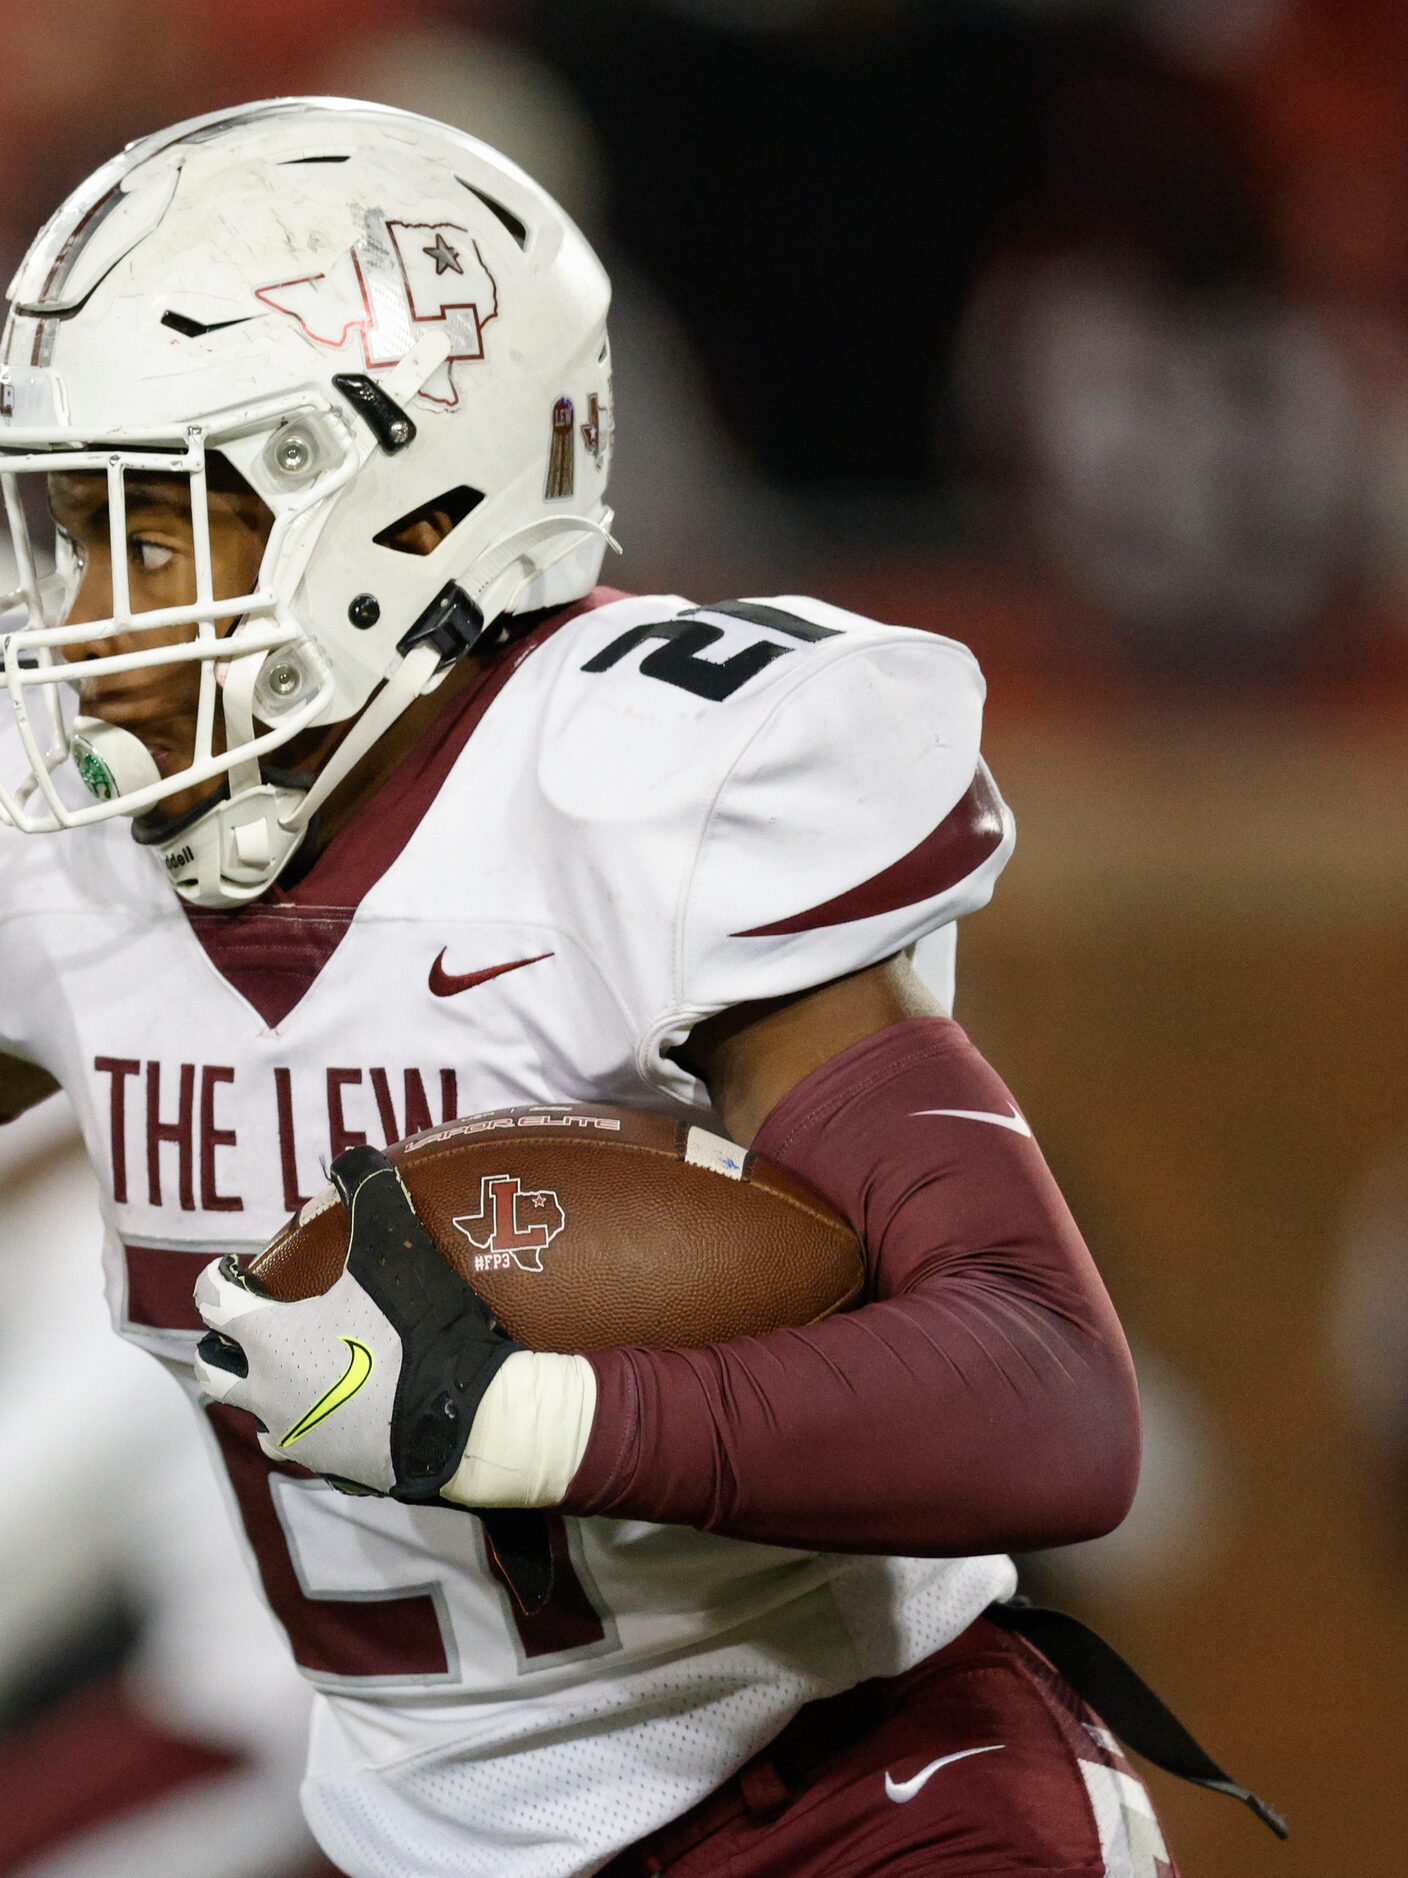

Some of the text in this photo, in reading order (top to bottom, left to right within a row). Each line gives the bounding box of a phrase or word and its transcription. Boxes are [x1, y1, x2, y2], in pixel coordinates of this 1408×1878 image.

[580, 600, 847, 702] 21
[95, 1056, 457, 1213] THE LEW
[517, 1115, 621, 1132] ELITE
[489, 1178, 549, 1253] L
[474, 1253, 511, 1272] #FP3
